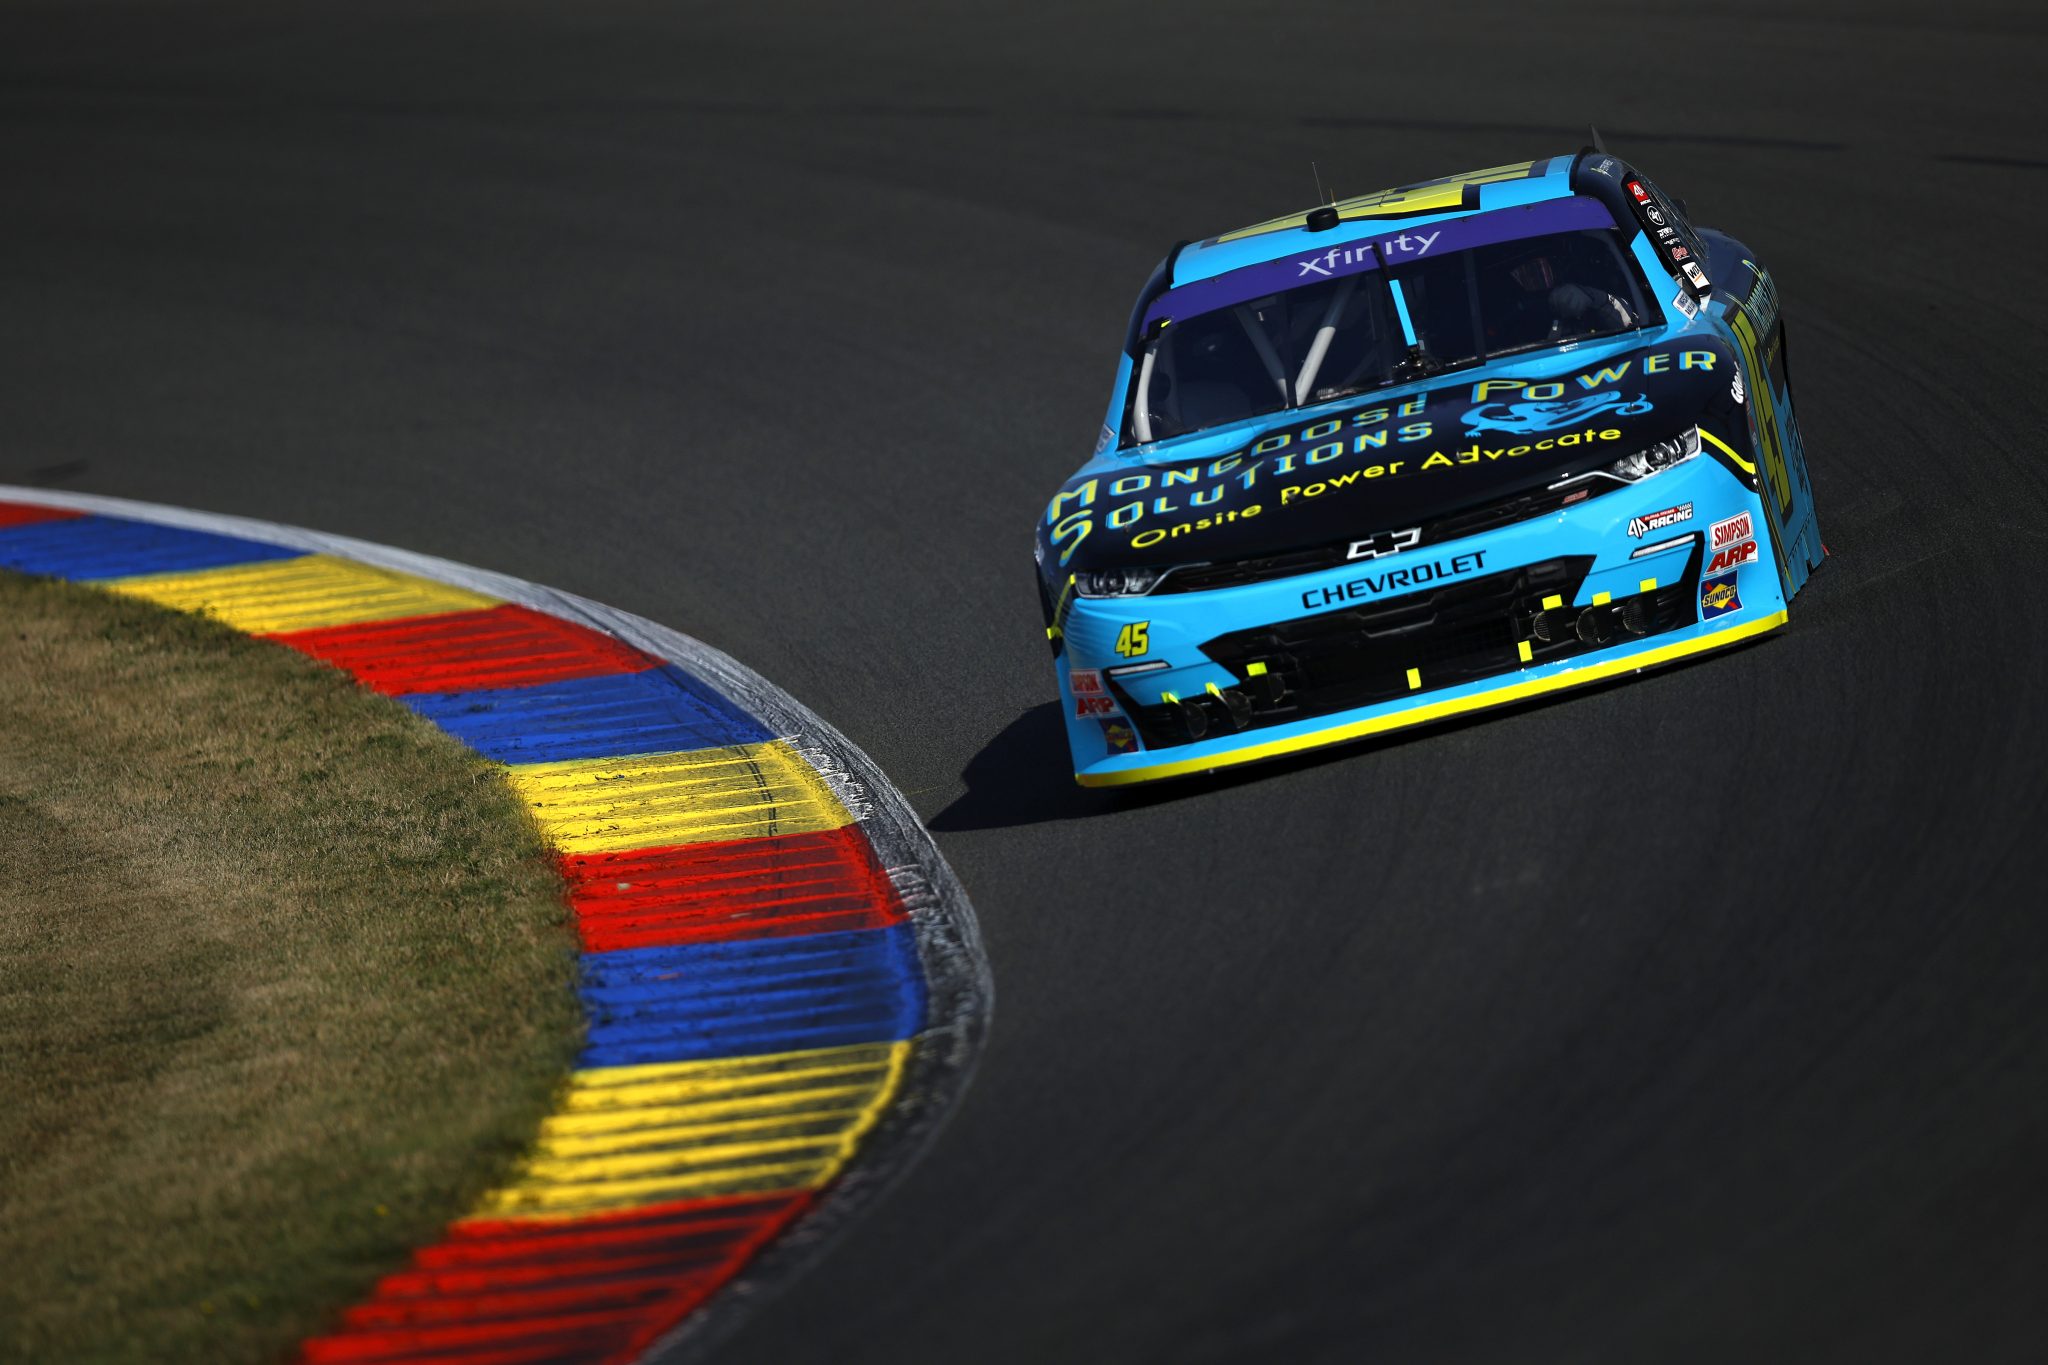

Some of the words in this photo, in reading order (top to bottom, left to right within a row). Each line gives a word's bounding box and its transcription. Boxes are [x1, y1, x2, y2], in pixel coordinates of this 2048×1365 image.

[1047, 392, 1428, 525] MONGOOSE
[1471, 351, 1717, 404] POWER
[1050, 421, 1434, 567] SOLUTIONS
[1131, 504, 1263, 549] Onsite
[1281, 460, 1404, 506] Power
[1421, 428, 1622, 471] Advocate
[1648, 508, 1693, 531] RACING
[1714, 515, 1750, 547] SIMPSON
[1705, 540, 1757, 573] ARP
[1301, 550, 1487, 610] CHEVROLET
[1703, 585, 1737, 607] SUNOCO
[1114, 620, 1151, 659] 45
